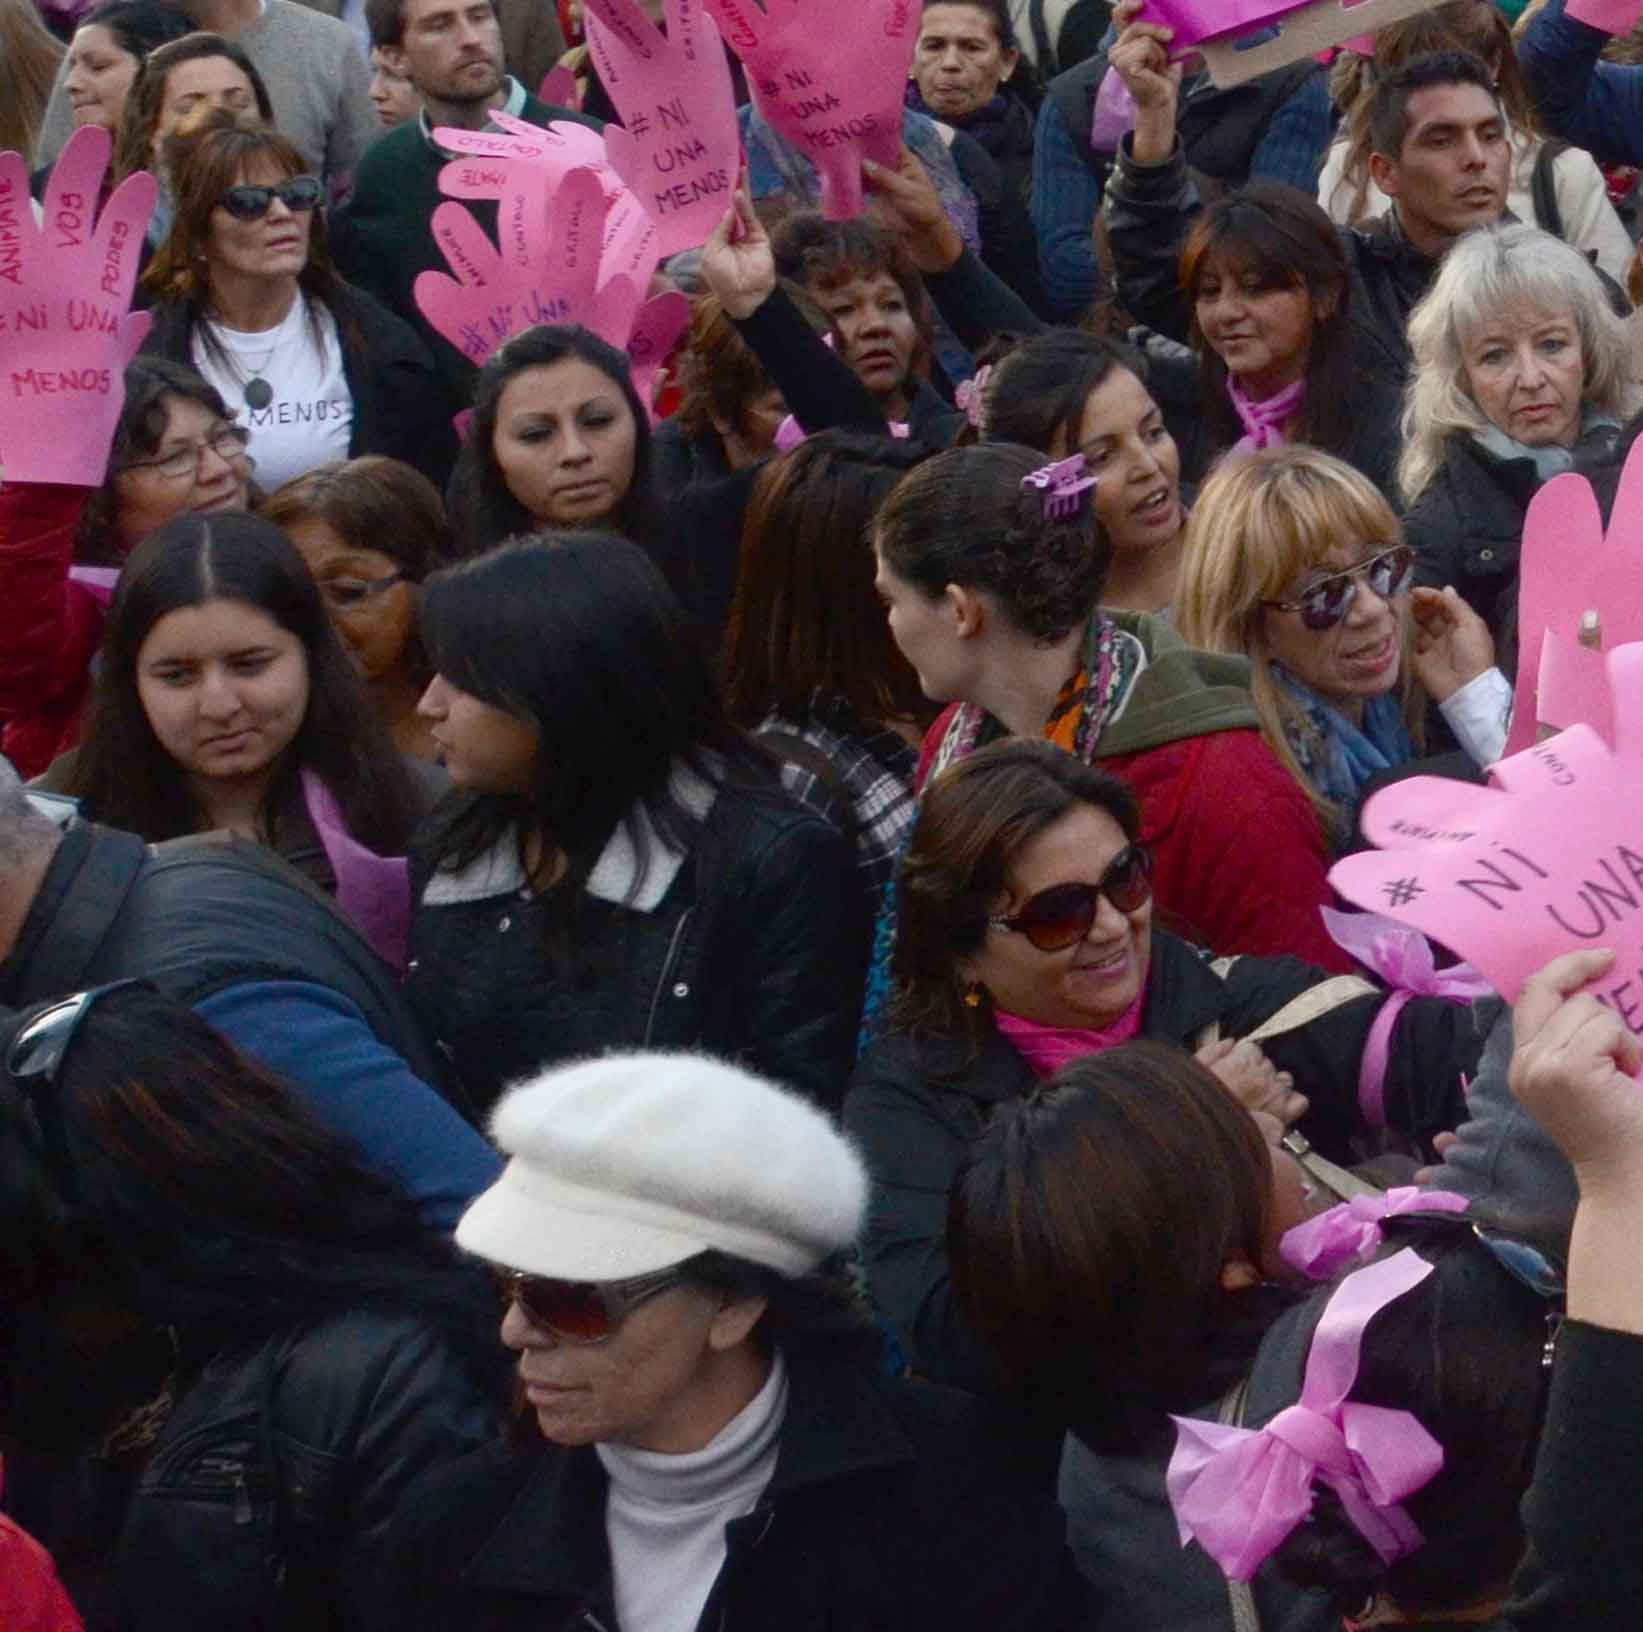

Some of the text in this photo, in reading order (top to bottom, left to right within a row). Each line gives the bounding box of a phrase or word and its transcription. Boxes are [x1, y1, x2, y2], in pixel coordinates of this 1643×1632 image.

[652, 142, 708, 173] UNA
[654, 168, 730, 216] MENOS
[57, 191, 83, 249] VOS
[101, 220, 129, 296] PODES
[68, 299, 119, 334] UNA
[11, 368, 112, 398] MENOS
[250, 398, 343, 427] MENOS
[1455, 844, 1549, 911] NI
